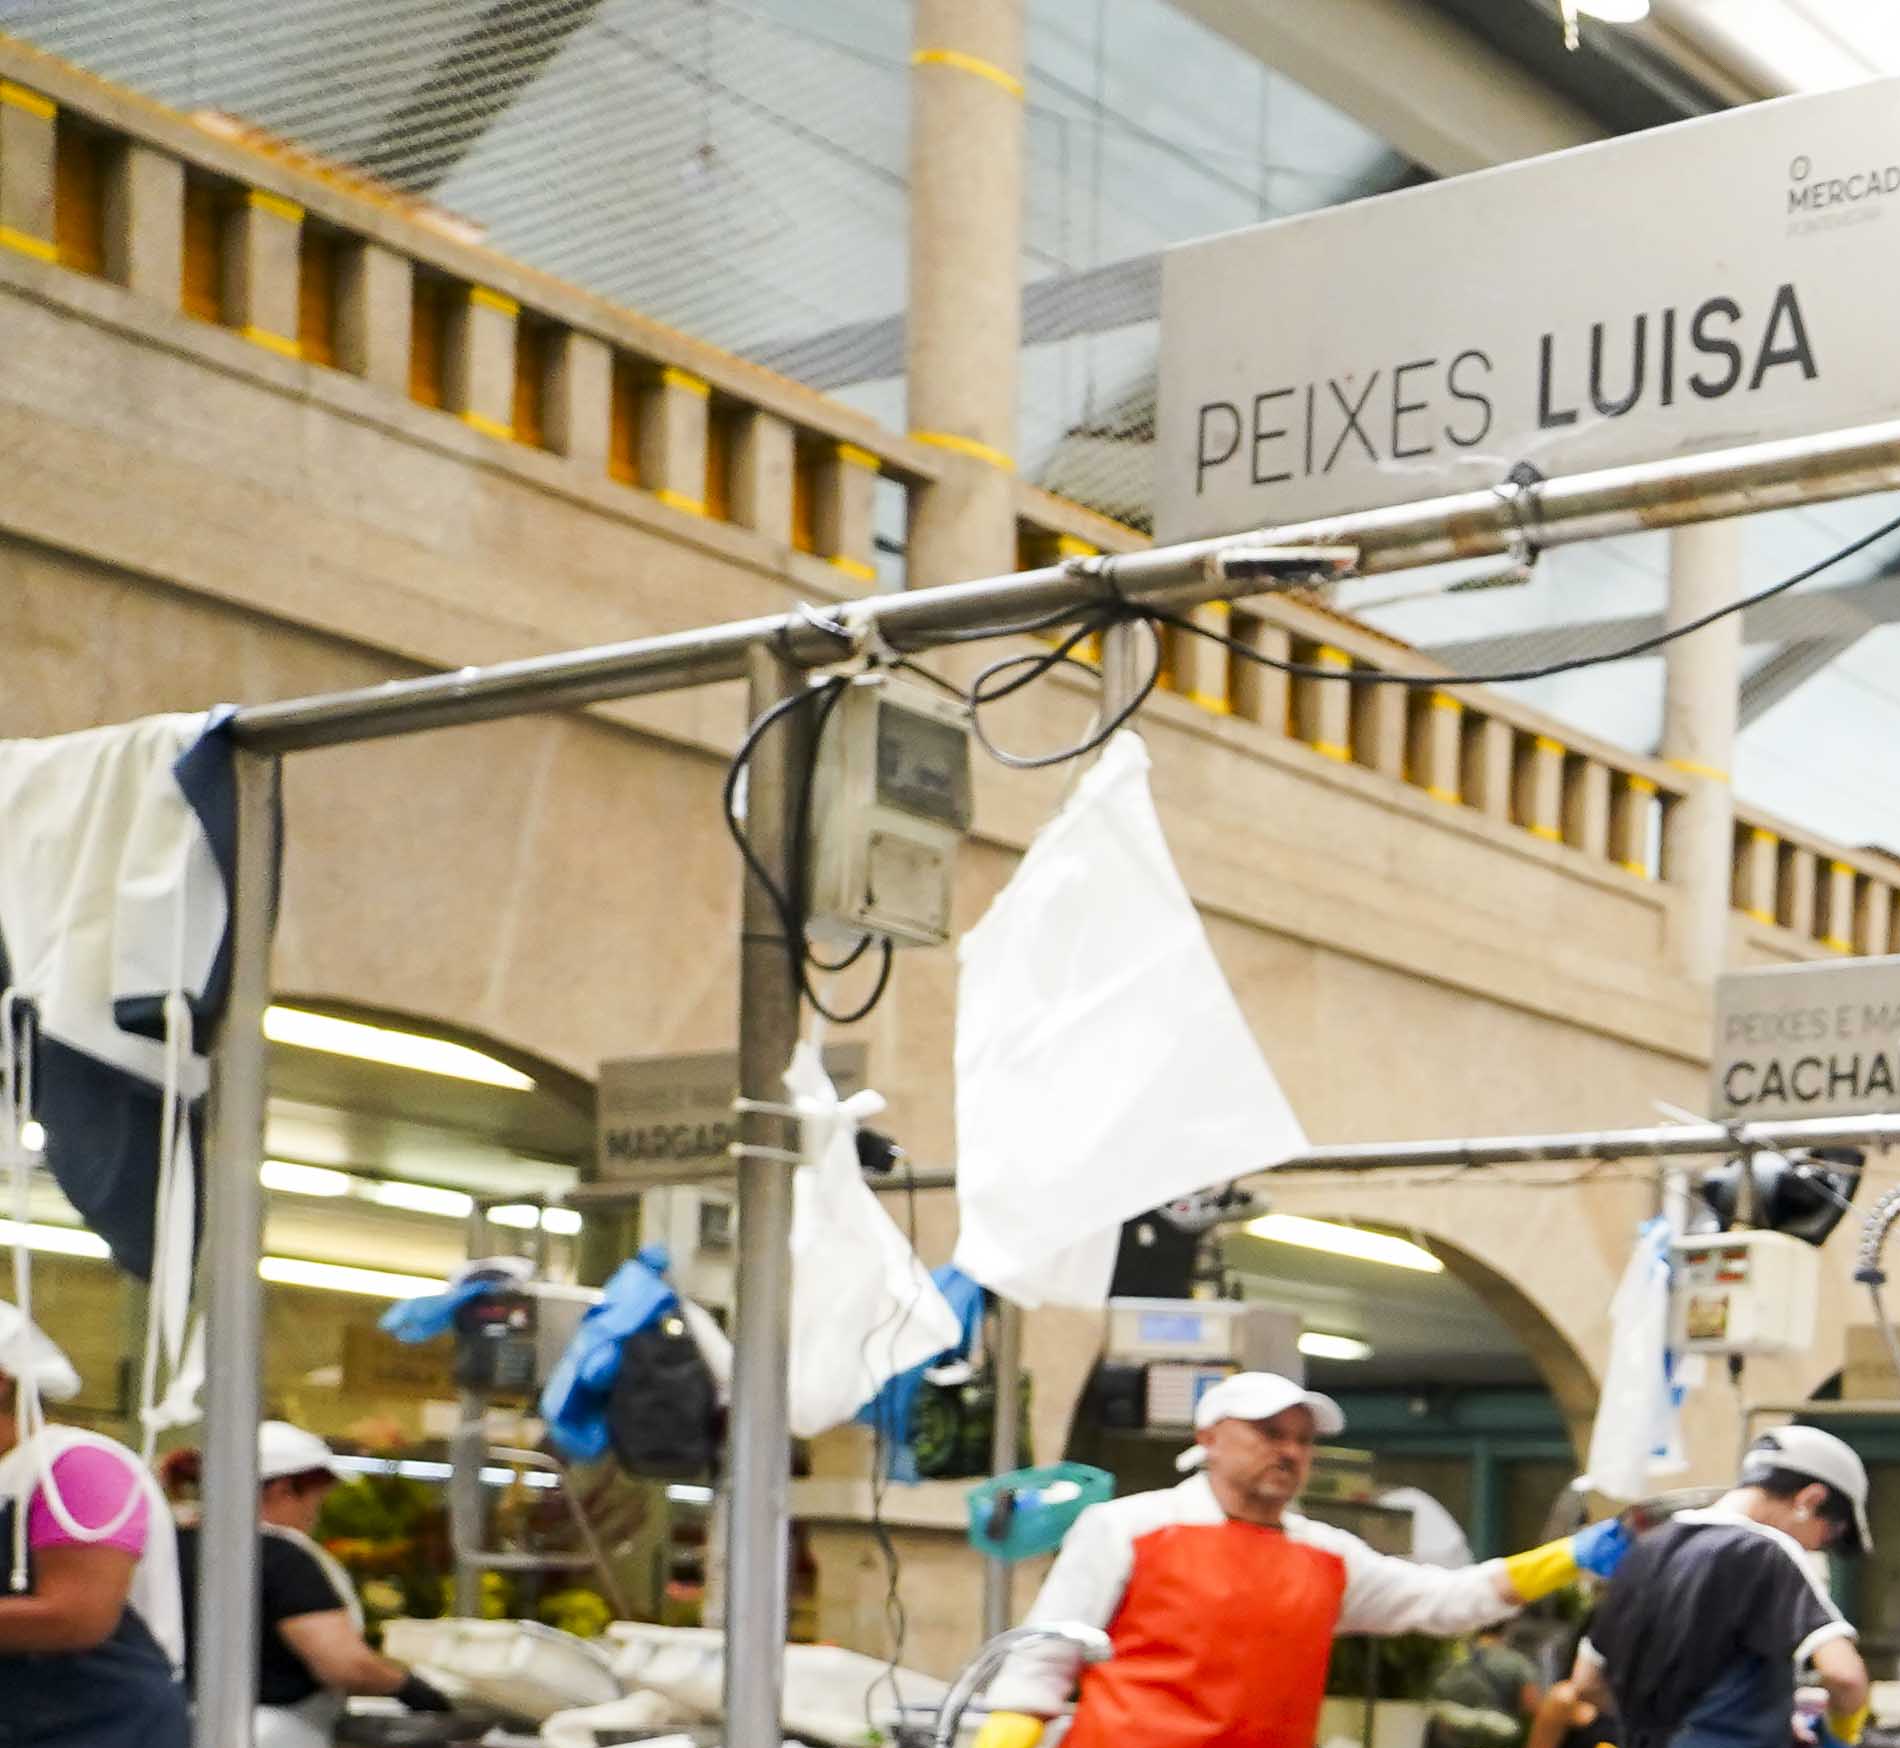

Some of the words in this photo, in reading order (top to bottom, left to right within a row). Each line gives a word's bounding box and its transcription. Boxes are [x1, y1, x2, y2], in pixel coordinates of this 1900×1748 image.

[1789, 154, 1812, 182] O
[1197, 349, 1493, 496] PEIXES
[1537, 283, 1820, 430] LUISA
